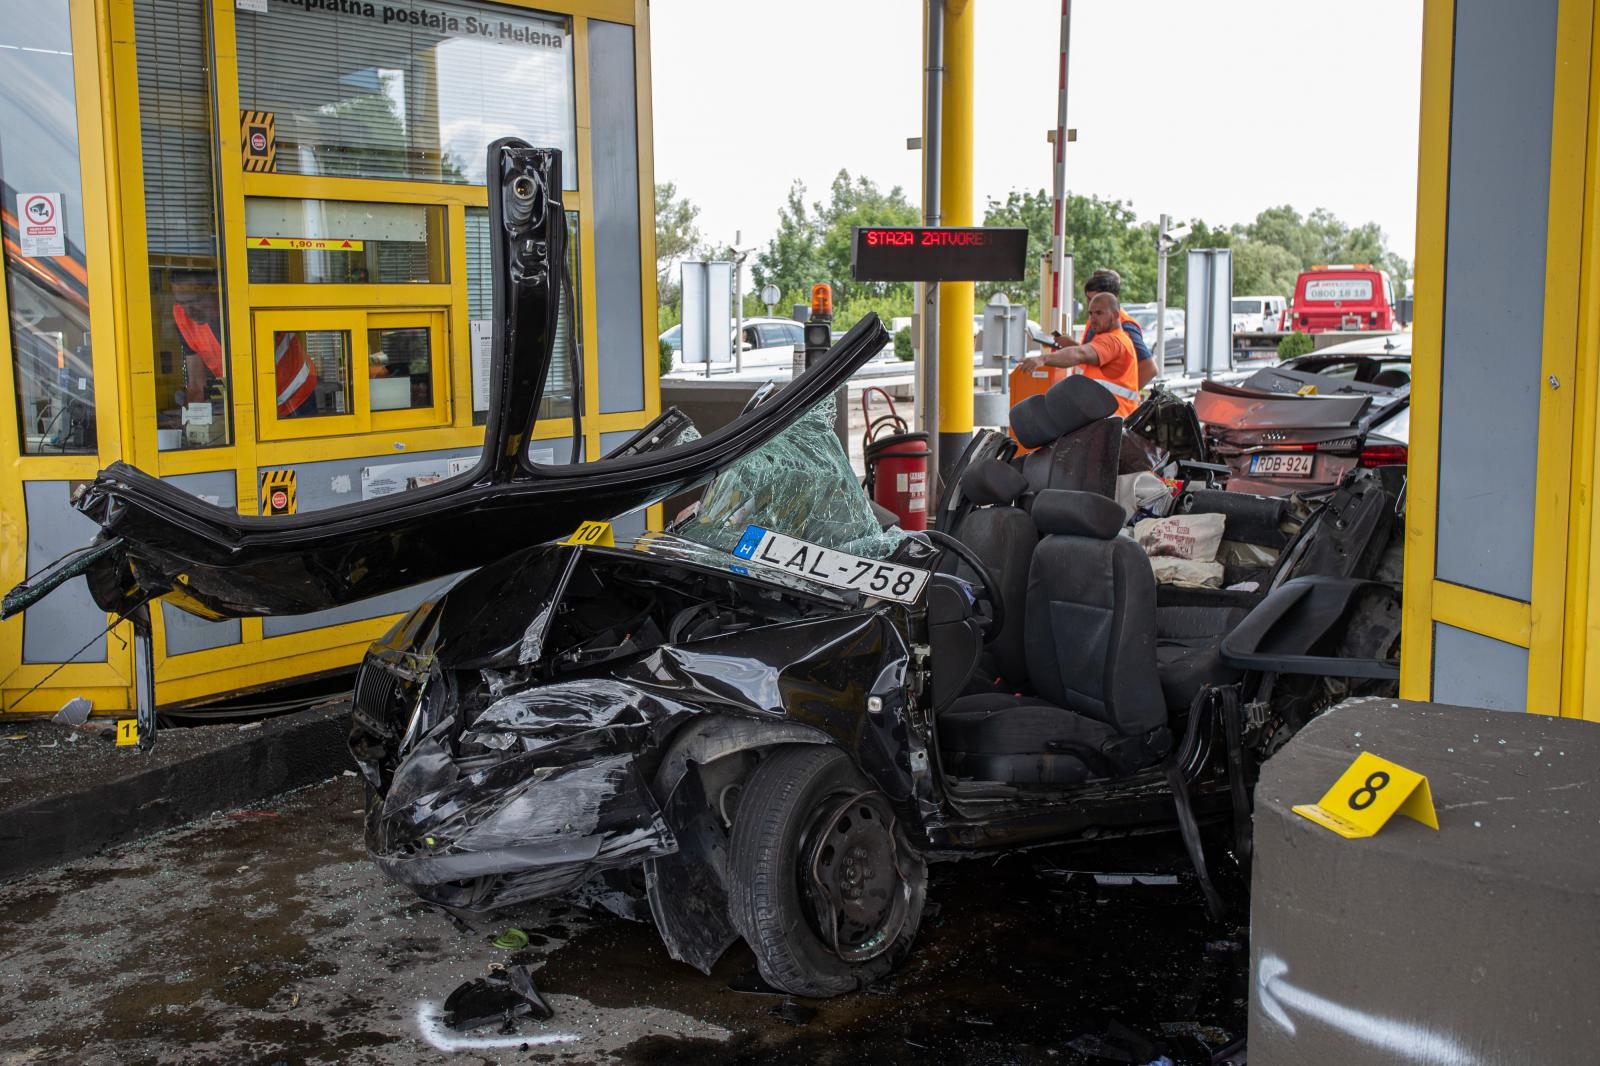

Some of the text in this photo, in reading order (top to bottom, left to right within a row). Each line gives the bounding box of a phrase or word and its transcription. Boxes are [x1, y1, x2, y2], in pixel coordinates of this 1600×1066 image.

[383, 6, 459, 33] postaja
[466, 16, 493, 37] Sv.
[500, 22, 563, 49] Helena
[290, 240, 312, 249] 1,90
[867, 231, 993, 247] STAZA ZATVORE
[1311, 289, 1336, 298] 0800
[1258, 456, 1309, 472] RDB-924
[577, 524, 602, 542] 10
[740, 536, 915, 596] H LAL-758
[1348, 771, 1390, 811] 8
